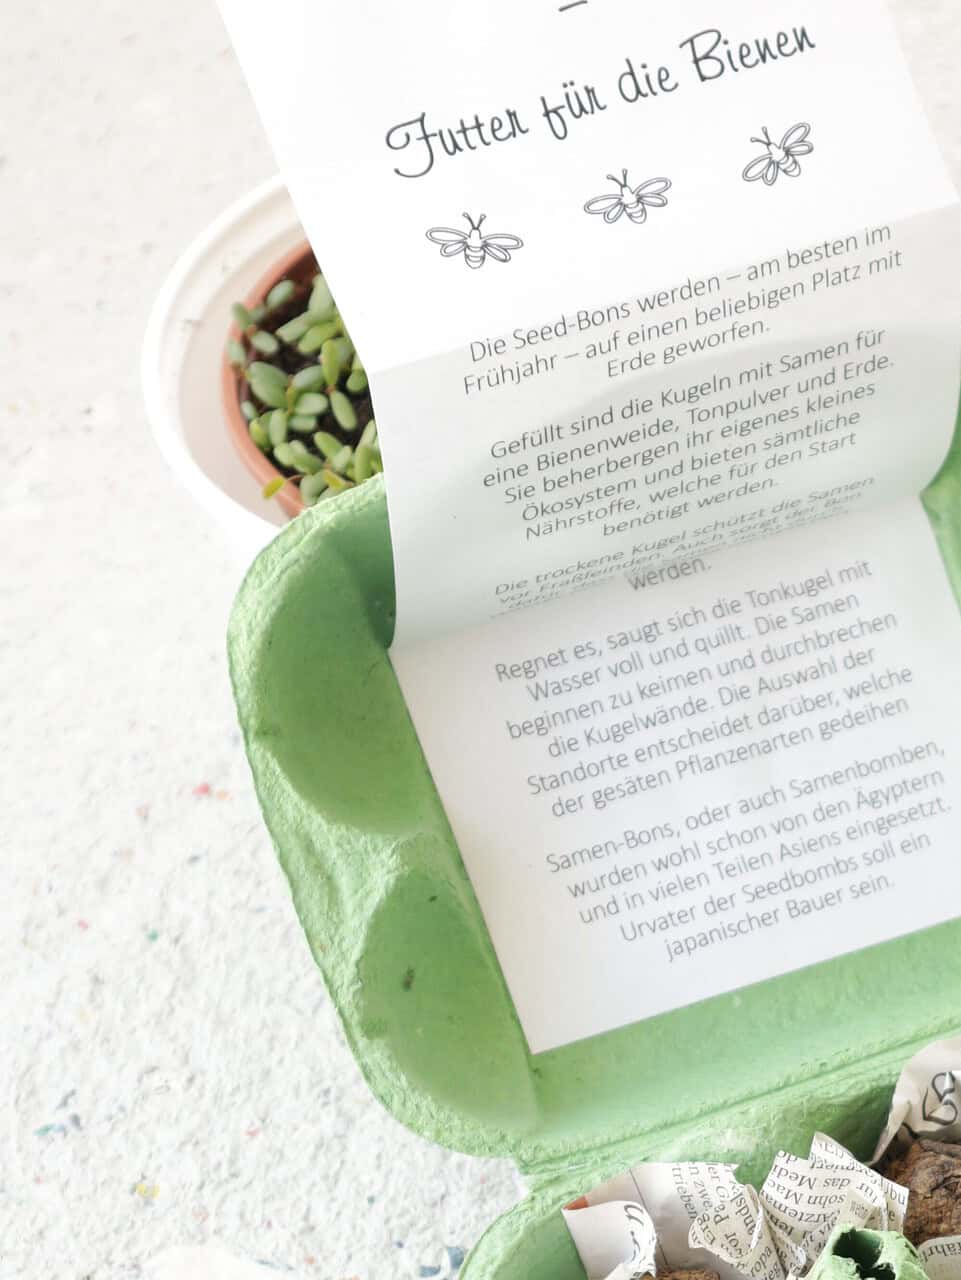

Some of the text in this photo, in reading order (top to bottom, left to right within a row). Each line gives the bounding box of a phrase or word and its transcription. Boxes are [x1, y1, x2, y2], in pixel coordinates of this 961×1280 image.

[385, 27, 816, 178] Futter für die Bienen
[464, 250, 902, 395] Frühjahr auf einen beliebigen Platz mit
[470, 226, 891, 362] Die Seed-Bons werden am besten im
[608, 321, 769, 378] Erde geworfen.
[483, 354, 894, 487] eine Bienenweide, Tonpulver und Erde.
[491, 330, 885, 458] Gefüllt sind die Kugeln mit Samen für
[505, 384, 875, 504] Sie beherbergen ihr eigenes kleines
[522, 412, 860, 521] Ökosystem und bieten sämtliche
[526, 432, 856, 540] Nährstoffe, welche für den Start
[603, 502, 690, 536] benötigt
[697, 478, 779, 508] werden.
[495, 560, 872, 682] Regnet es, saugt sich die Tonkugel mit
[627, 558, 712, 592] werden.
[506, 613, 898, 740] beginnen zu keimen und durchbrechen
[526, 594, 860, 702] Wasser voll und quillt. Die Samen
[548, 648, 874, 758] die Kugelwände. Die Auswahl der
[527, 668, 912, 795] Standorte entscheidet darüber, welche
[552, 698, 909, 818] der gesäten Pflanzenarten gedeihen
[546, 741, 944, 873] Samen-Bons, oder auch Samenbomben,
[567, 771, 944, 898] wurden wohl schon von den Ägyptern
[579, 797, 951, 924] und in vielen Teilen Asiens eingesetzt.
[619, 832, 931, 942] Urvater der Seedbombs soll ein
[664, 875, 895, 963] japanischer Bauer sein.
[807, 1188, 846, 1210] sohn
[823, 1178, 851, 1190] das
